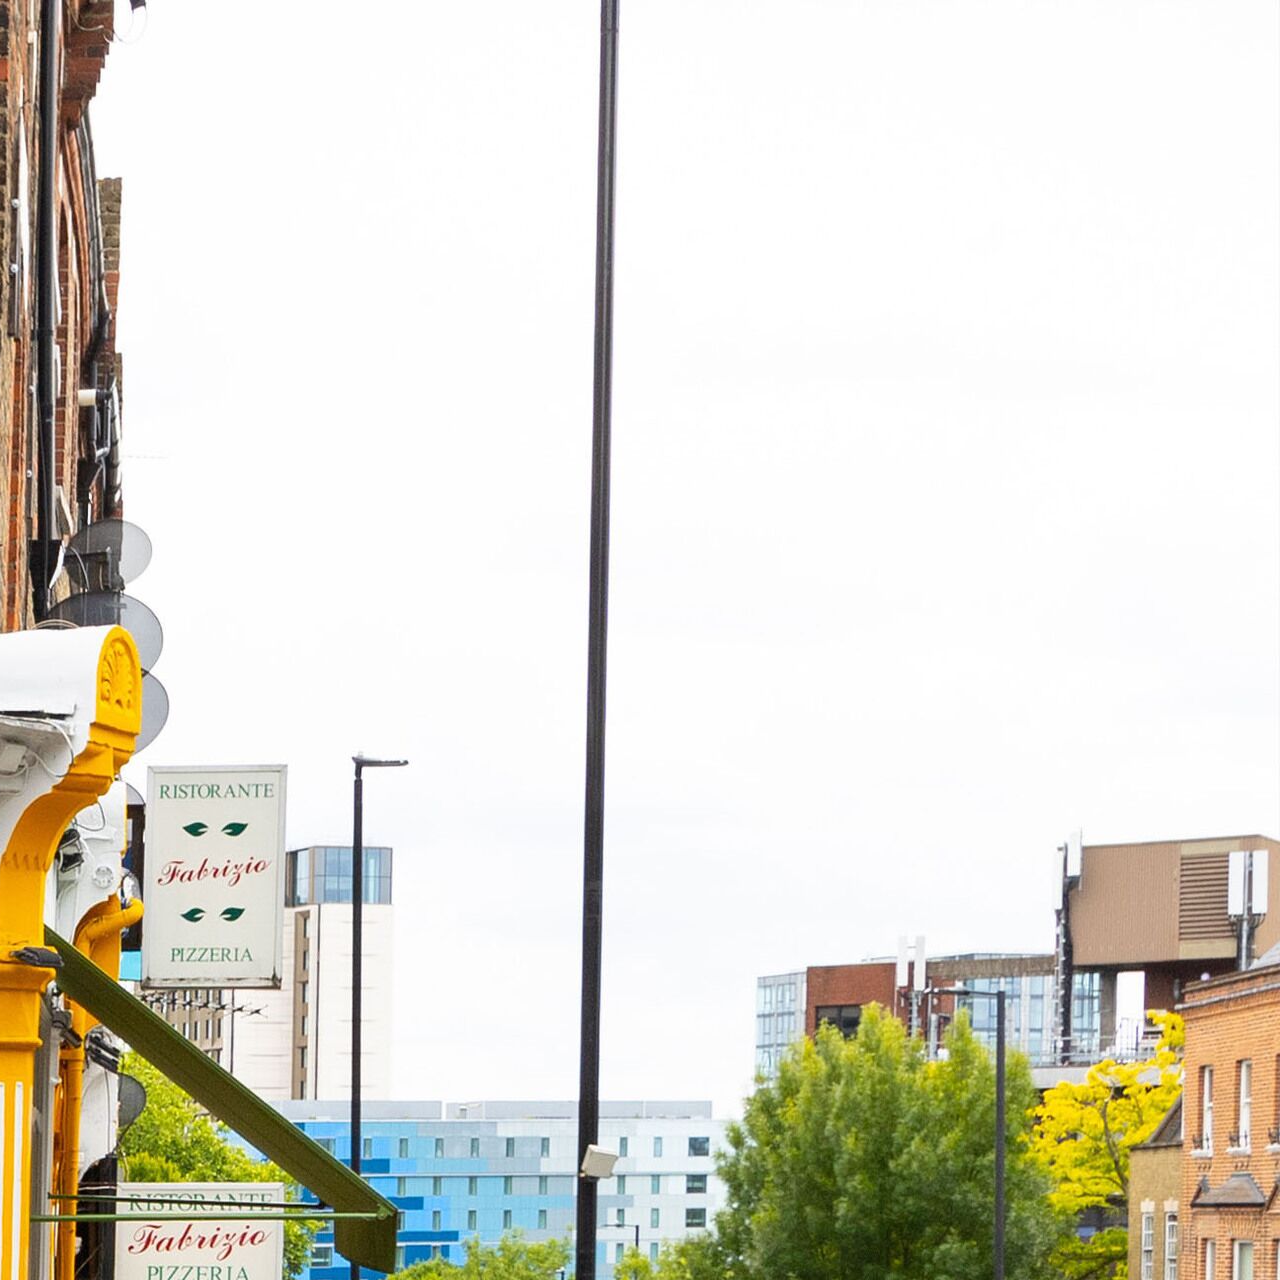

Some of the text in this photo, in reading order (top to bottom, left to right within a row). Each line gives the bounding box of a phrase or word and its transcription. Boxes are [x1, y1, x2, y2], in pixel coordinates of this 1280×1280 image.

[159, 783, 275, 799] RISTORANTE
[157, 856, 273, 887] Fabrizio
[170, 948, 253, 962] PIZZERIA
[127, 1223, 273, 1261] Fabrizio
